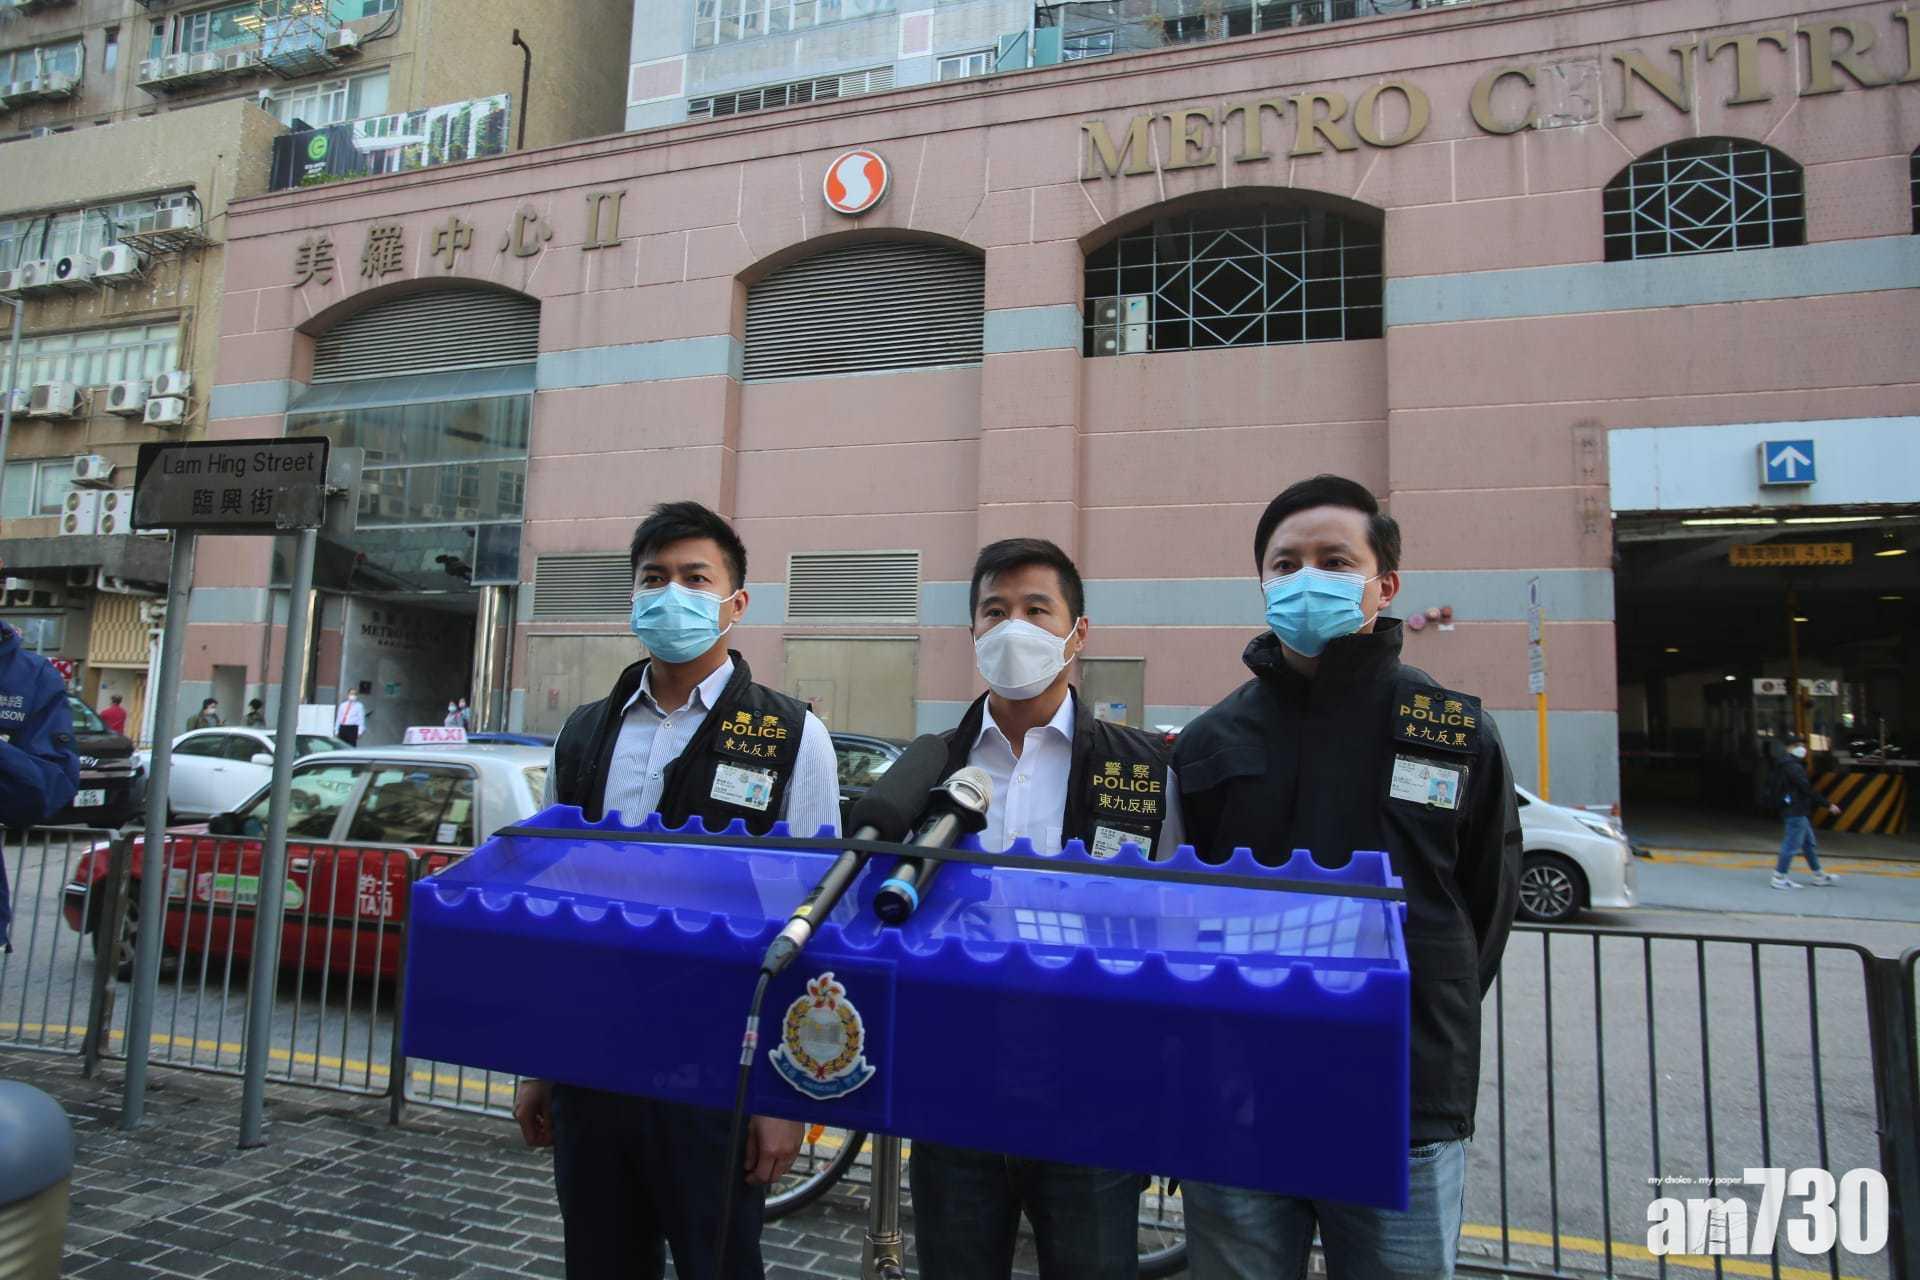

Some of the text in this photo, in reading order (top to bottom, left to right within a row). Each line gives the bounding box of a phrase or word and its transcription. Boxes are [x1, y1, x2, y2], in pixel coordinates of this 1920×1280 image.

[1080, 78, 1431, 181] METRO
[163, 451, 315, 478] Lam Hing Street
[192, 487, 274, 515] 臨興街
[1414, 694, 1463, 714] 警察
[735, 711, 779, 727] 警察
[1400, 704, 1476, 728] POLICE
[419, 728, 465, 741] TAXI
[721, 720, 788, 739] POLICE
[1405, 723, 1467, 746] 東九反黑
[724, 737, 777, 758] 東九反黑
[1104, 761, 1150, 779] 警察
[1093, 774, 1161, 793] POLICE
[1099, 793, 1157, 813] 東九反黑
[360, 894, 393, 917] TAXI
